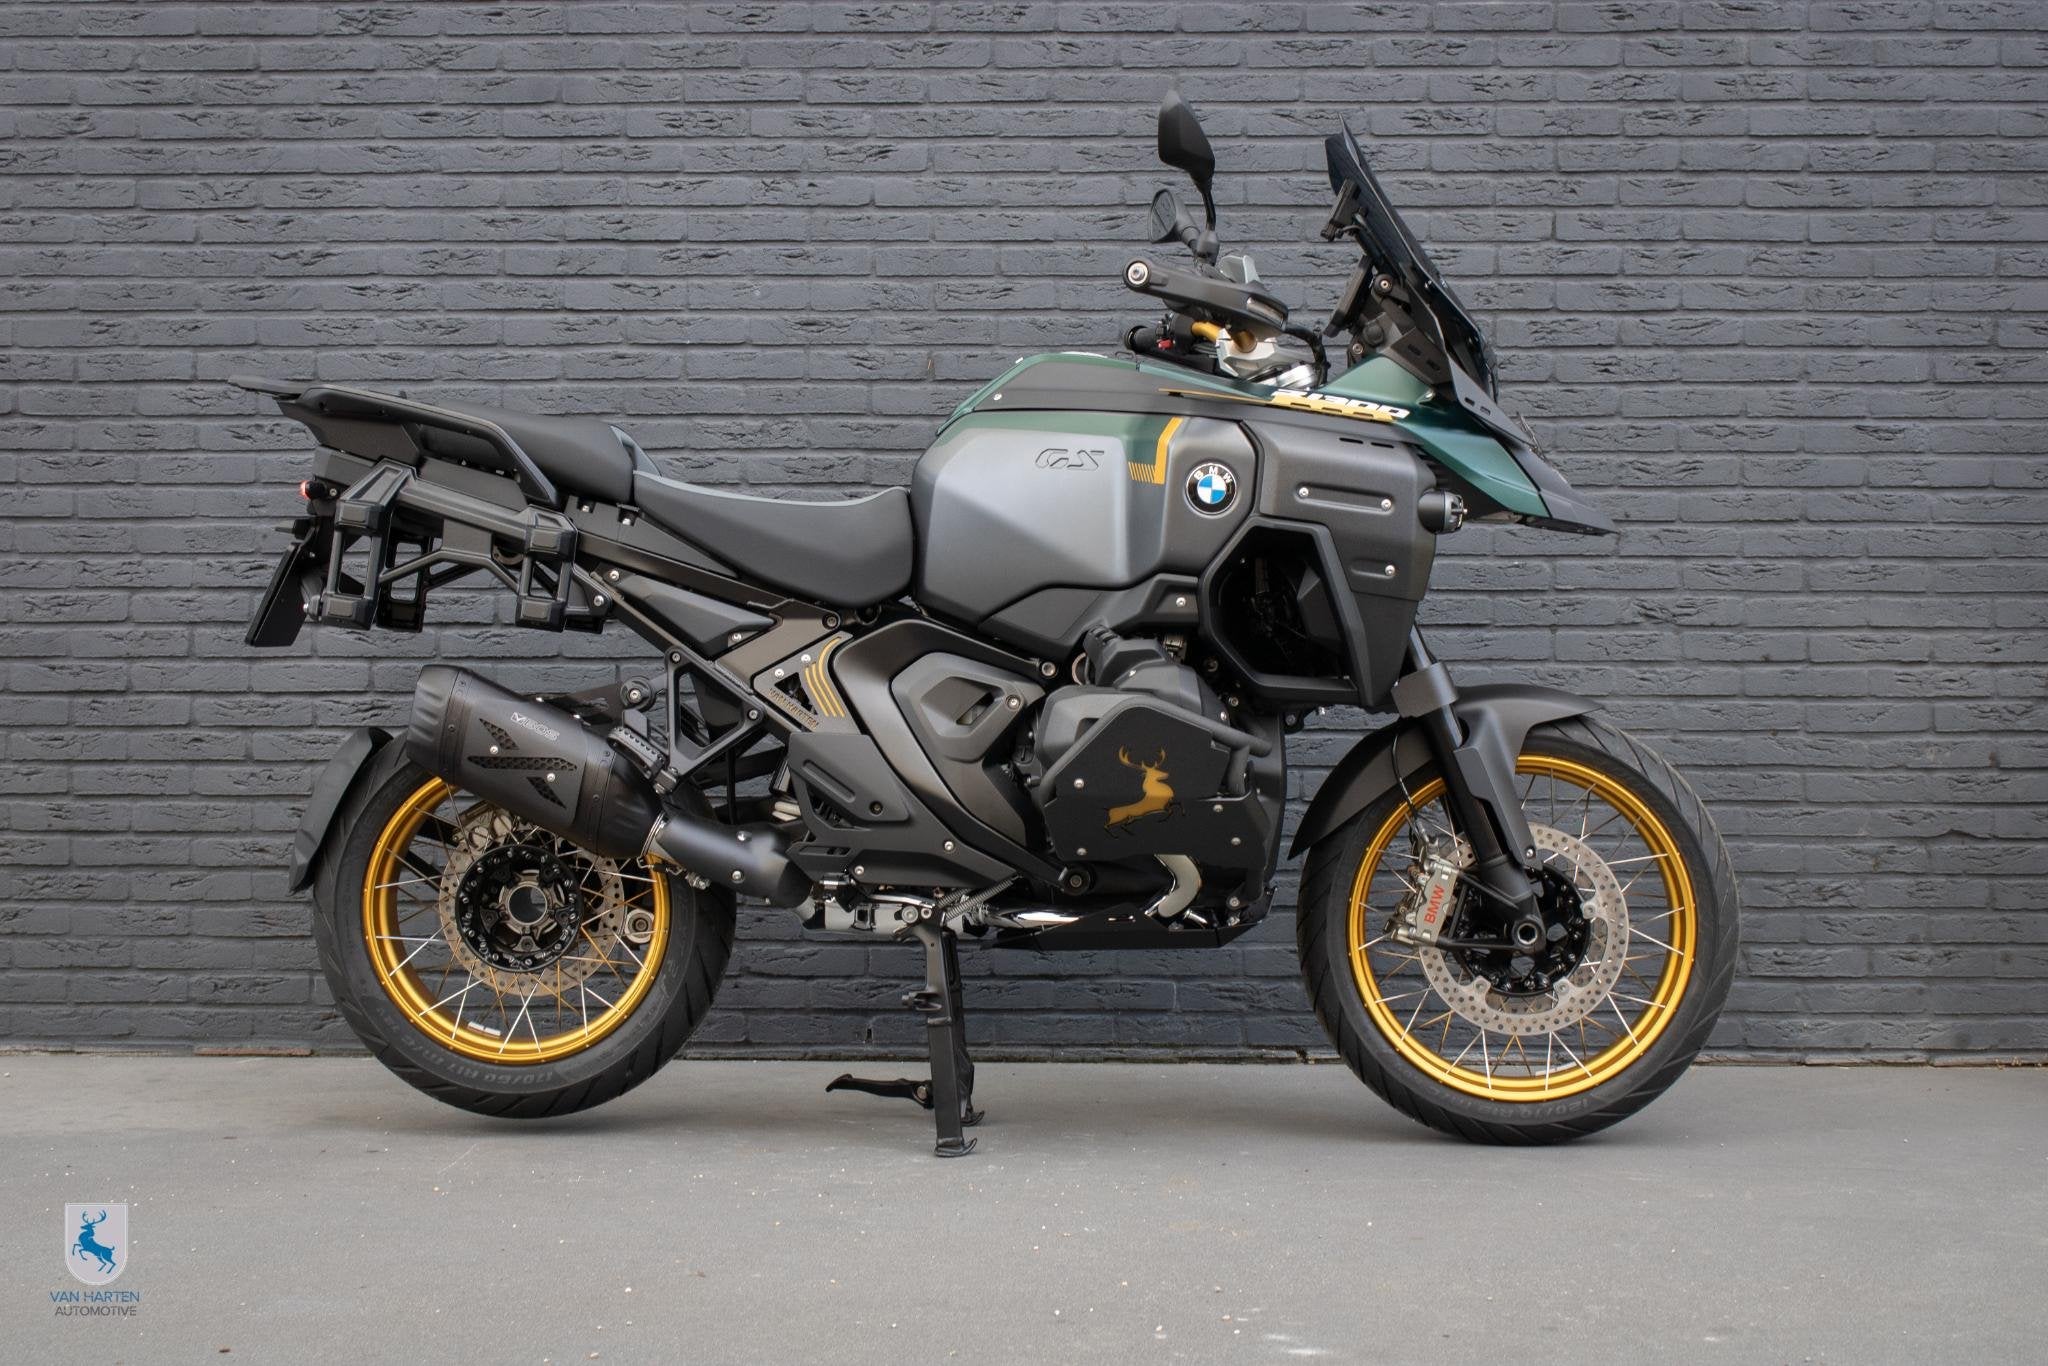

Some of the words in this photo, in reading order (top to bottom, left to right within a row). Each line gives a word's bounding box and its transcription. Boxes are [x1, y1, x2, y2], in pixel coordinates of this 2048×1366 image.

[1035, 448, 1105, 471] GS
[1194, 465, 1233, 484] BMW
[1423, 883, 1445, 924] BMW
